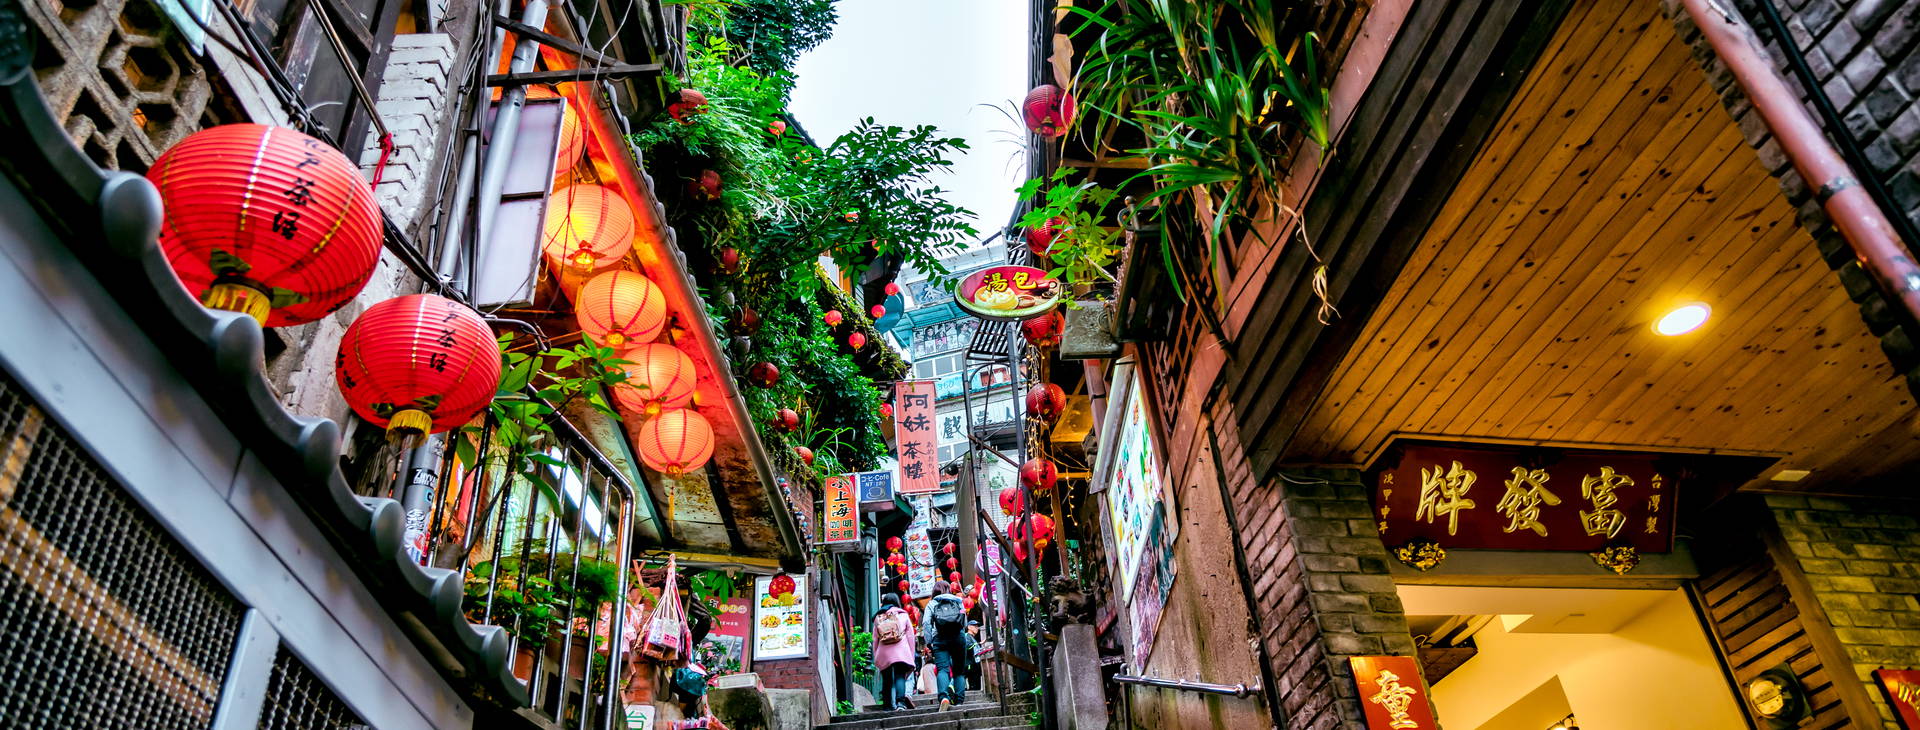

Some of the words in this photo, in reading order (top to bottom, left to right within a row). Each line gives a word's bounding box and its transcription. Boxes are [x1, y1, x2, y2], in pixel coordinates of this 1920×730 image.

[983, 271, 1038, 292] 湯包
[832, 480, 852, 518] 小上海
[1415, 459, 1635, 540] 富發牌
[1368, 669, 1419, 730] 童
